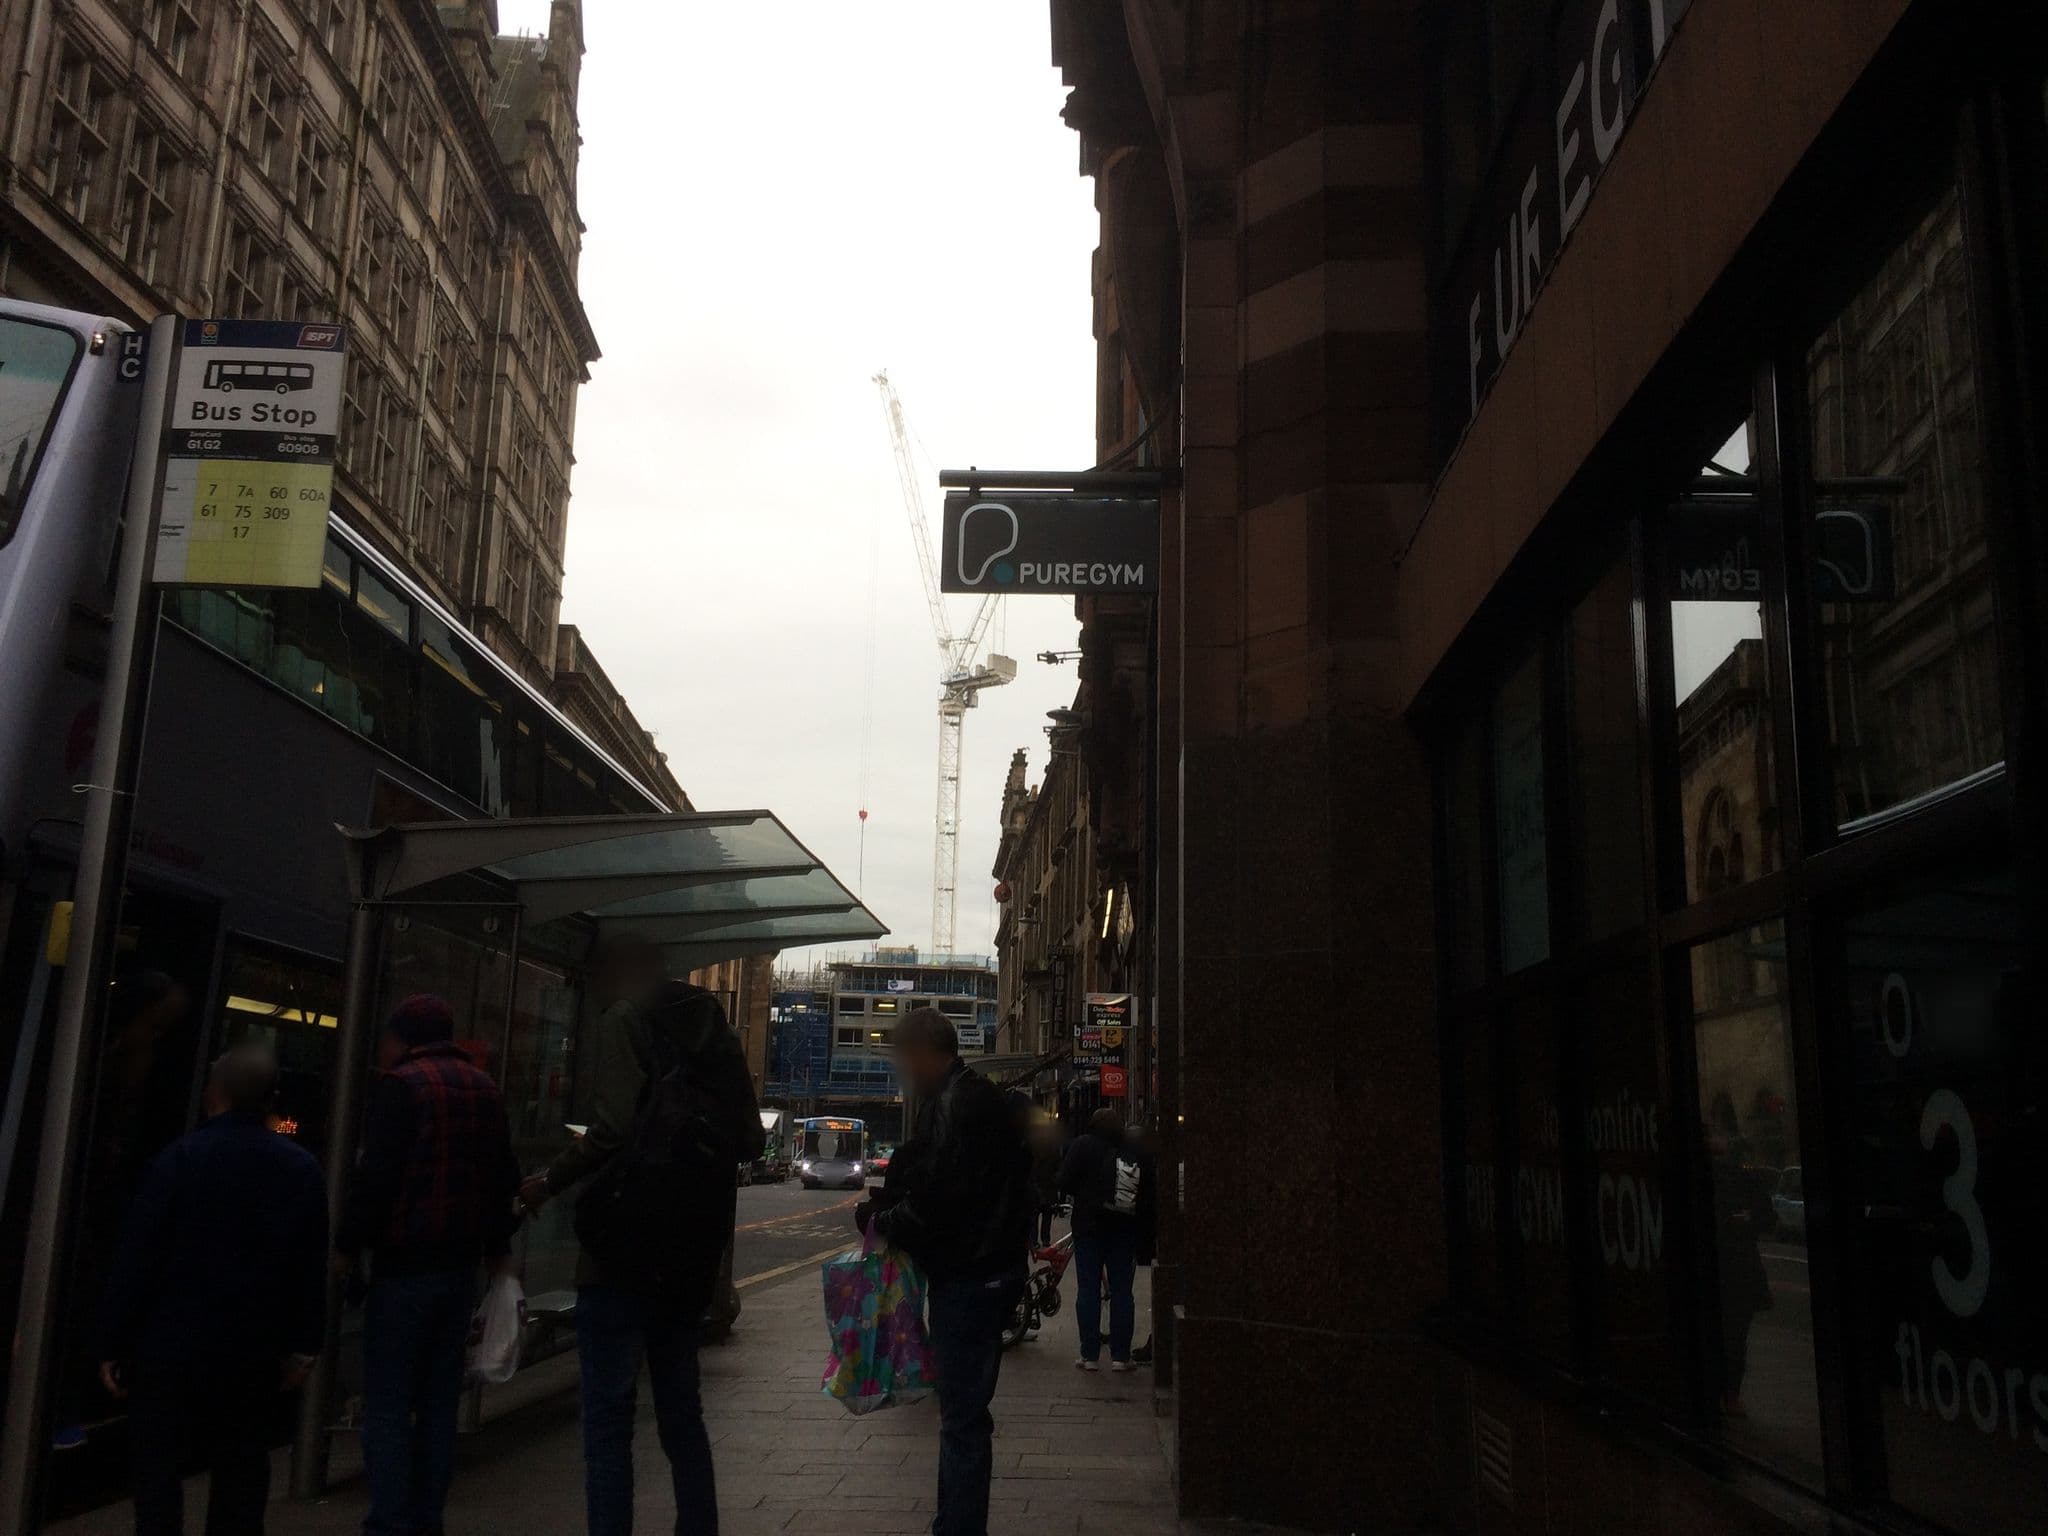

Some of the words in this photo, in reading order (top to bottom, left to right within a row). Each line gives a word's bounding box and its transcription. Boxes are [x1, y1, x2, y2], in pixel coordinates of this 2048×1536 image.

[191, 401, 241, 421] Bus
[251, 402, 317, 427] Stop
[277, 442, 320, 454] 60908
[209, 484, 218, 496] 7
[238, 485, 254, 498] 7A
[270, 487, 288, 500] 60
[299, 488, 325, 502] 60A
[201, 504, 217, 517] 61
[234, 505, 252, 518] 75
[263, 508, 290, 520] 309
[232, 526, 250, 539] 17
[1019, 563, 1144, 585] PUREGYM
[1920, 1089, 1992, 1319] 3
